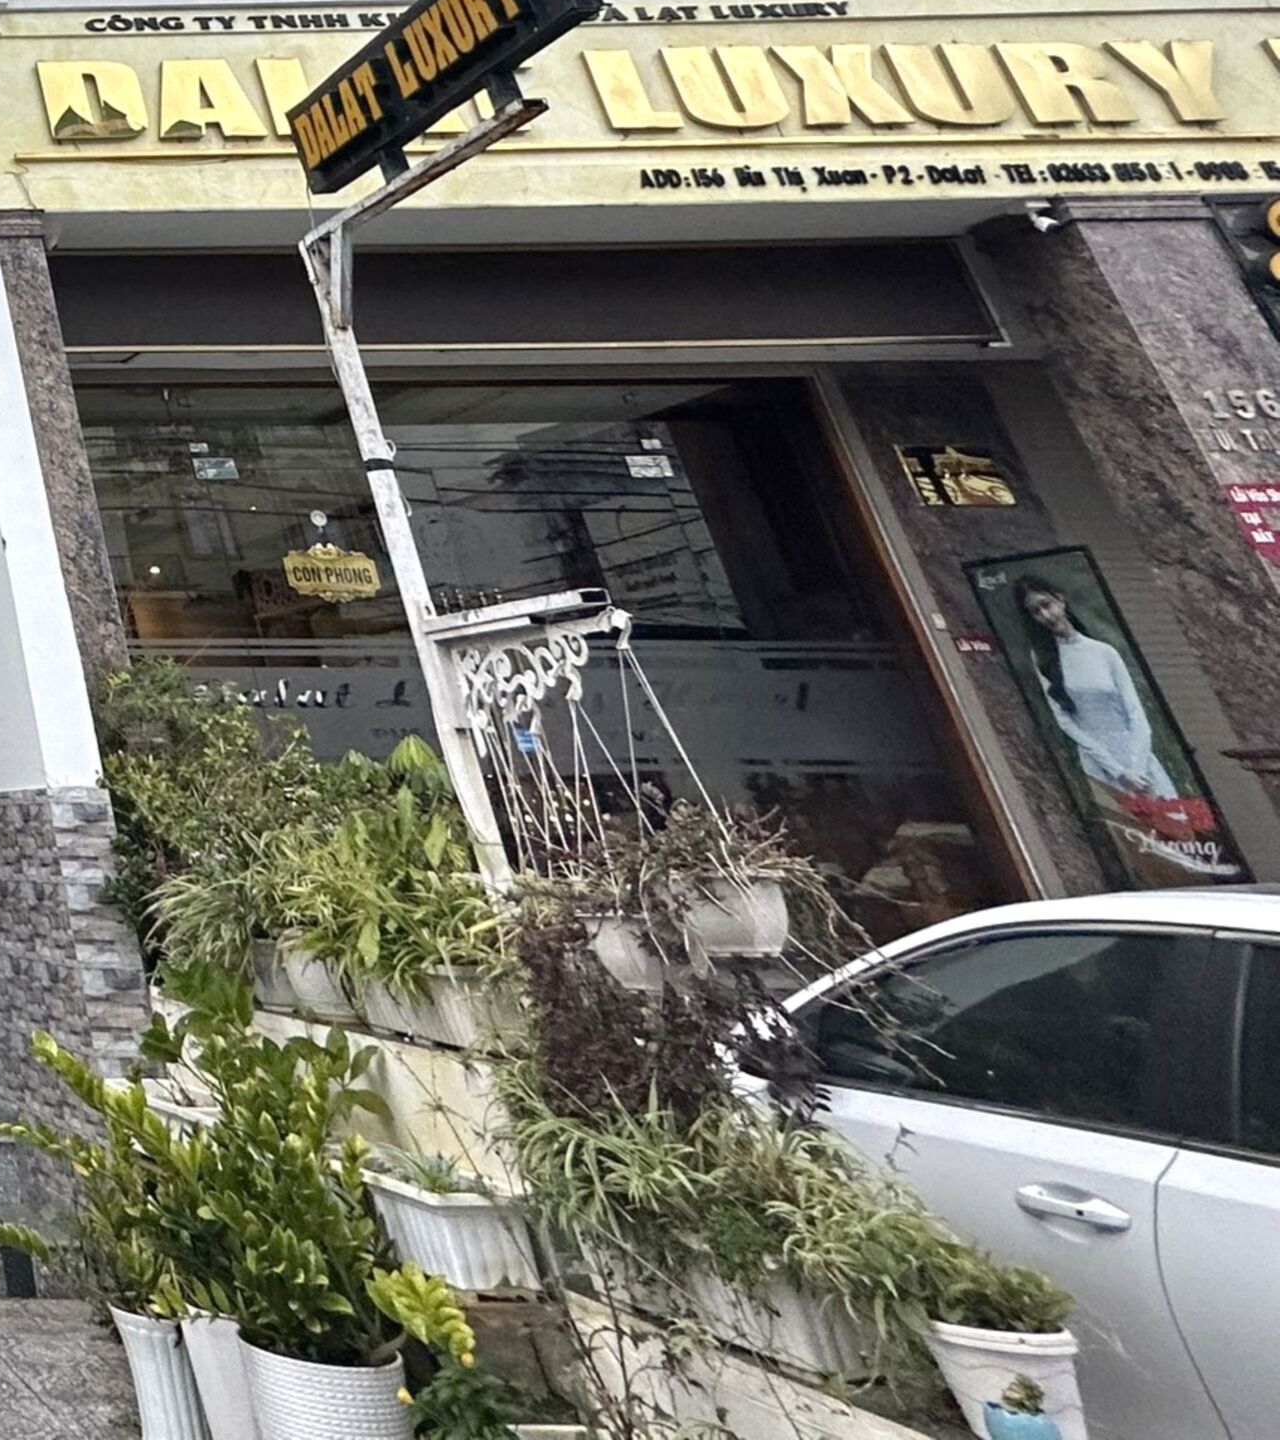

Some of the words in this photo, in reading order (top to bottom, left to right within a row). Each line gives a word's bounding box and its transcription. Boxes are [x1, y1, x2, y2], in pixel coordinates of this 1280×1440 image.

[83, 13, 186, 33] CÔNG
[192, 15, 236, 31] TY
[248, 13, 350, 30] TNHH
[635, 4, 699, 23] LẠT
[712, 0, 850, 19] LUXURY
[581, 39, 1229, 130] LUXURY
[293, 61, 383, 170] DALAT
[1203, 388, 1280, 420] 156
